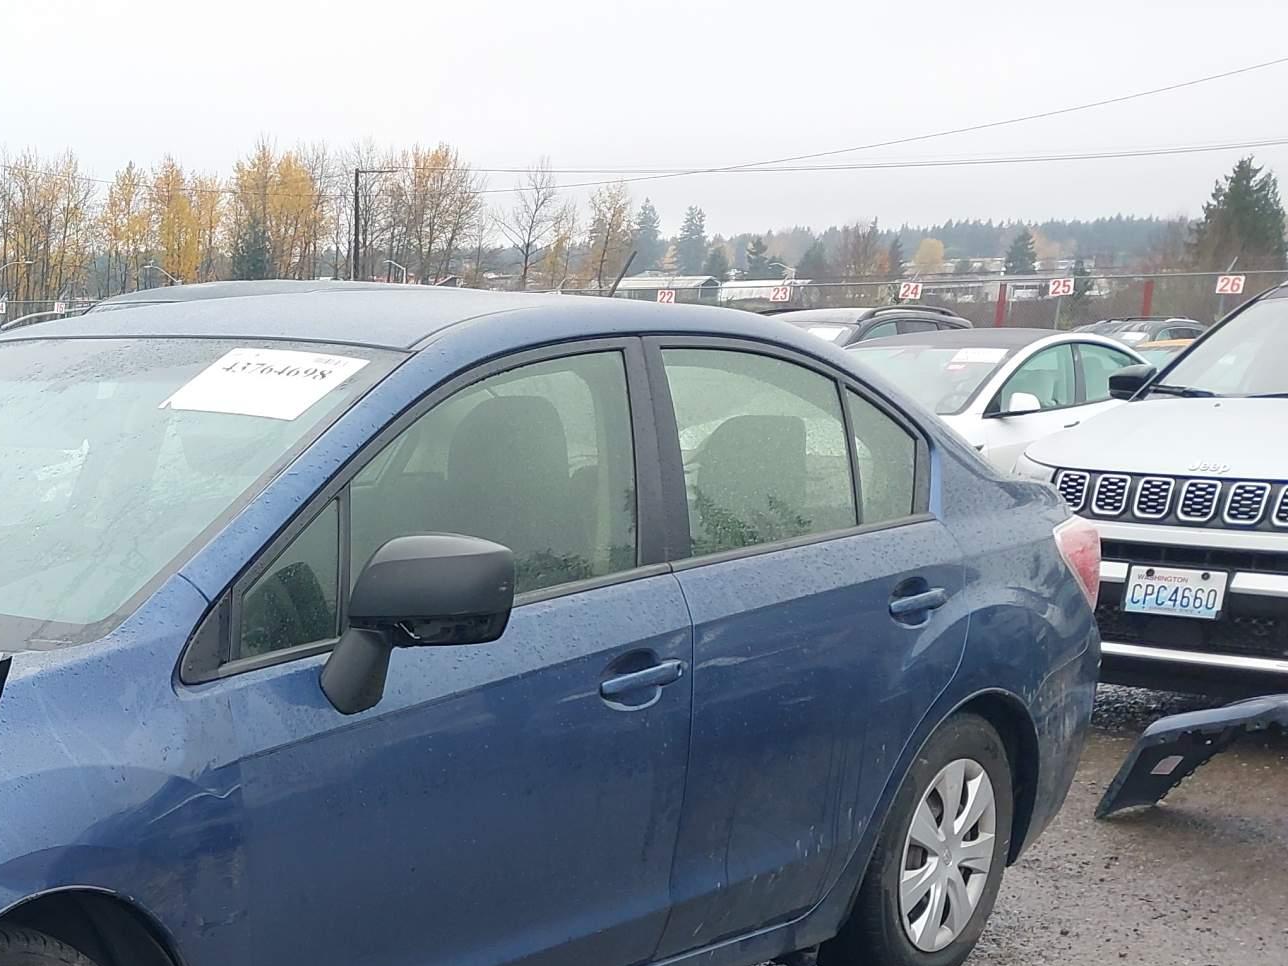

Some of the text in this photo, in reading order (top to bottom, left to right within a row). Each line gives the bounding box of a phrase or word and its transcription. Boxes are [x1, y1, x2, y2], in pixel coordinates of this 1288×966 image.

[901, 283, 920, 298] 24
[1051, 279, 1072, 295] 25
[1219, 276, 1242, 293] 26
[659, 291, 673, 303] 22
[772, 287, 788, 300] 23
[1187, 457, 1231, 475] Jeep
[1130, 583, 1218, 610] CPC4660
